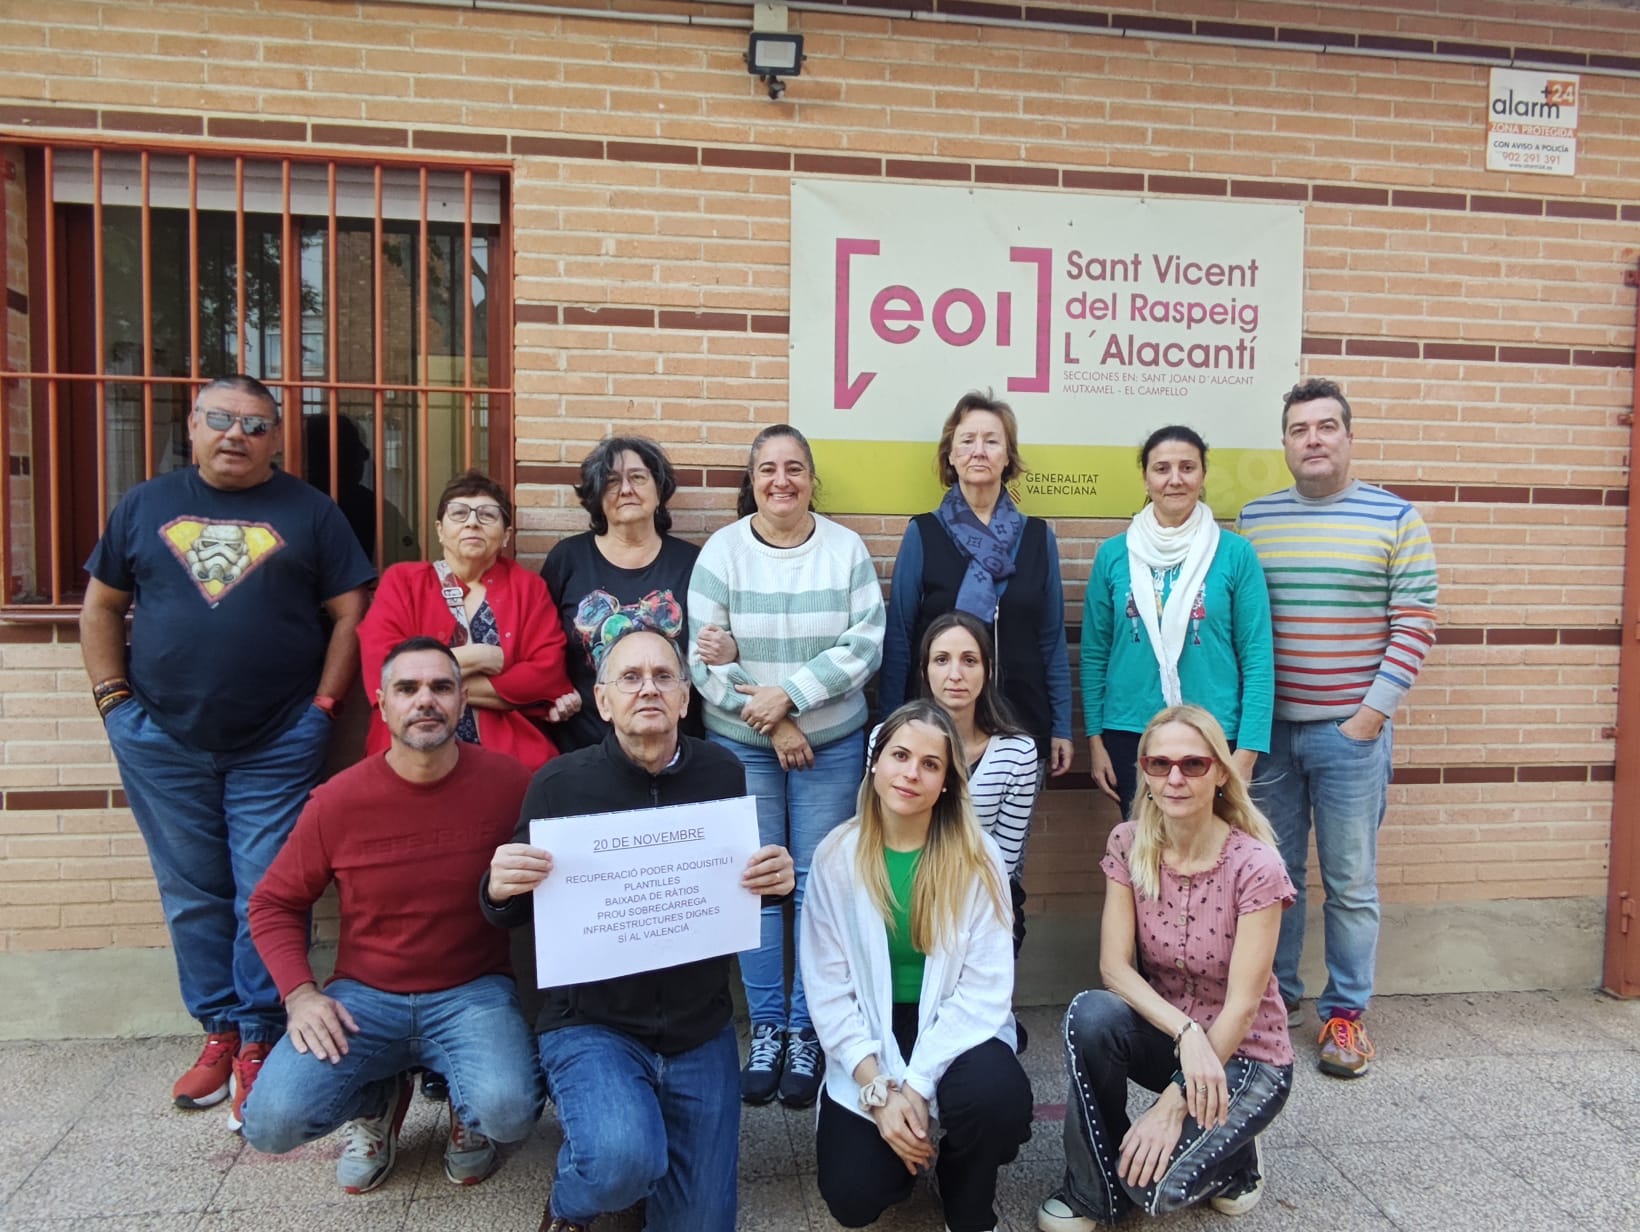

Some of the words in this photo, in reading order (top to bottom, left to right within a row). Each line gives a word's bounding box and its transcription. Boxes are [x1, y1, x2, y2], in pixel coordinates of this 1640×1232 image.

[1492, 89, 1560, 119] alarm
[1491, 123, 1519, 133] ZONA
[1521, 124, 1574, 138] PROTEGIDA
[1493, 141, 1509, 149] CON
[1511, 143, 1533, 151] AVISO
[1503, 152, 1520, 162] 902
[1523, 153, 1540, 163] 291
[1545, 155, 1560, 165] 391
[1066, 250, 1142, 282] Sant
[1152, 254, 1259, 287] Vicent
[1065, 291, 1117, 321] del
[1130, 293, 1259, 333] Raspeig
[1063, 371, 1120, 382] SECCIONES
[1122, 373, 1137, 382] EN:
[1141, 373, 1166, 383] SANT
[1169, 374, 1196, 384] JOAN
[1063, 384, 1114, 394] MUTXAMEL
[1125, 386, 1135, 395] EL
[1138, 386, 1188, 397] CAMPELLO
[1025, 472, 1099, 484] GENERALITAT
[1027, 485, 1097, 496] VALENCIANA
[593, 839, 609, 851] 20
[612, 836, 630, 849] DE
[633, 827, 705, 846] NOVEMBRE
[565, 867, 638, 884] RECUPERACIÓ
[640, 864, 674, 876] PODER
[676, 857, 728, 872] ADQUISITIU
[624, 876, 681, 891] PLANTILLES
[605, 893, 647, 906] BAIXADA
[649, 891, 662, 901] DE
[583, 912, 684, 935] INFRAESTRUCTURES
[685, 905, 721, 919] DIGNES
[597, 909, 626, 920] PROU
[629, 932, 641, 942] AL
